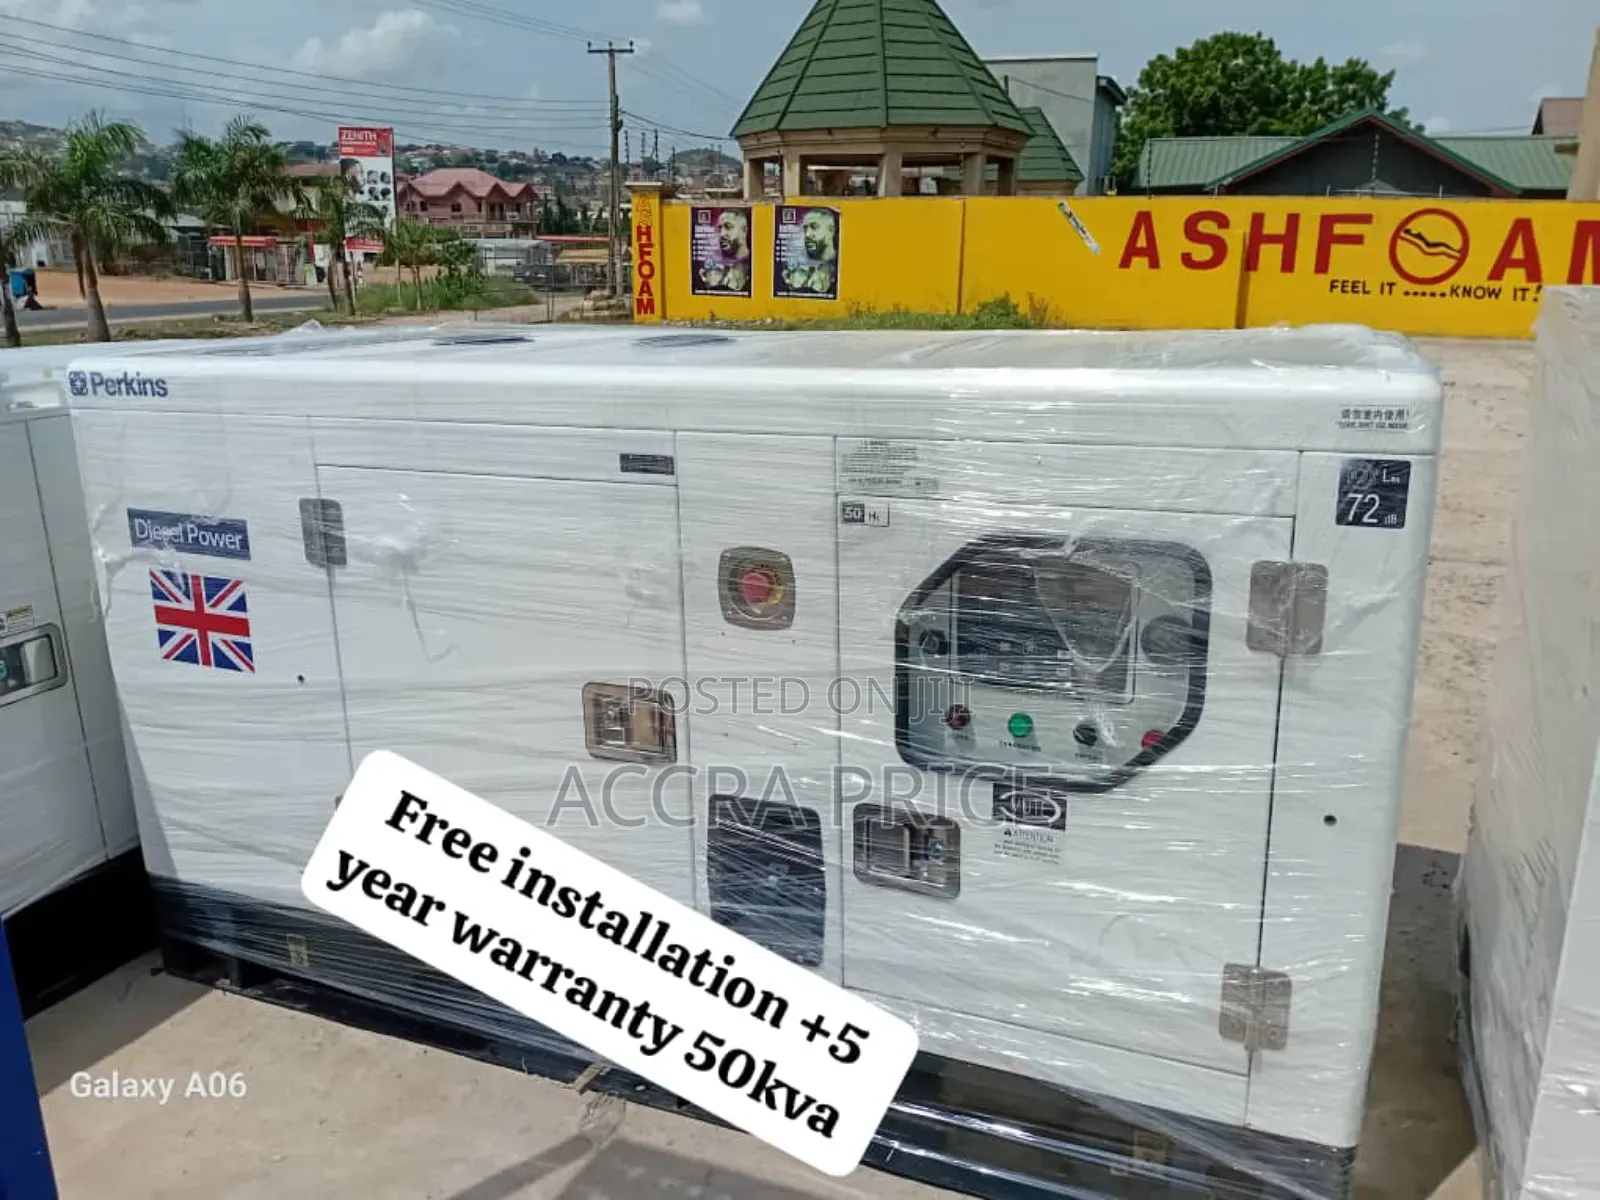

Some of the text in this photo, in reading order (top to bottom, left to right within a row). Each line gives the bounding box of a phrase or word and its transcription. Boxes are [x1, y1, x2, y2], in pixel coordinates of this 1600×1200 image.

[1329, 279, 1371, 295] FEEL
[1380, 281, 1397, 296] IT
[1512, 284, 1543, 302] IT!
[90, 371, 168, 398] Perkins
[1347, 493, 1379, 523] 72
[186, 523, 243, 549] Power
